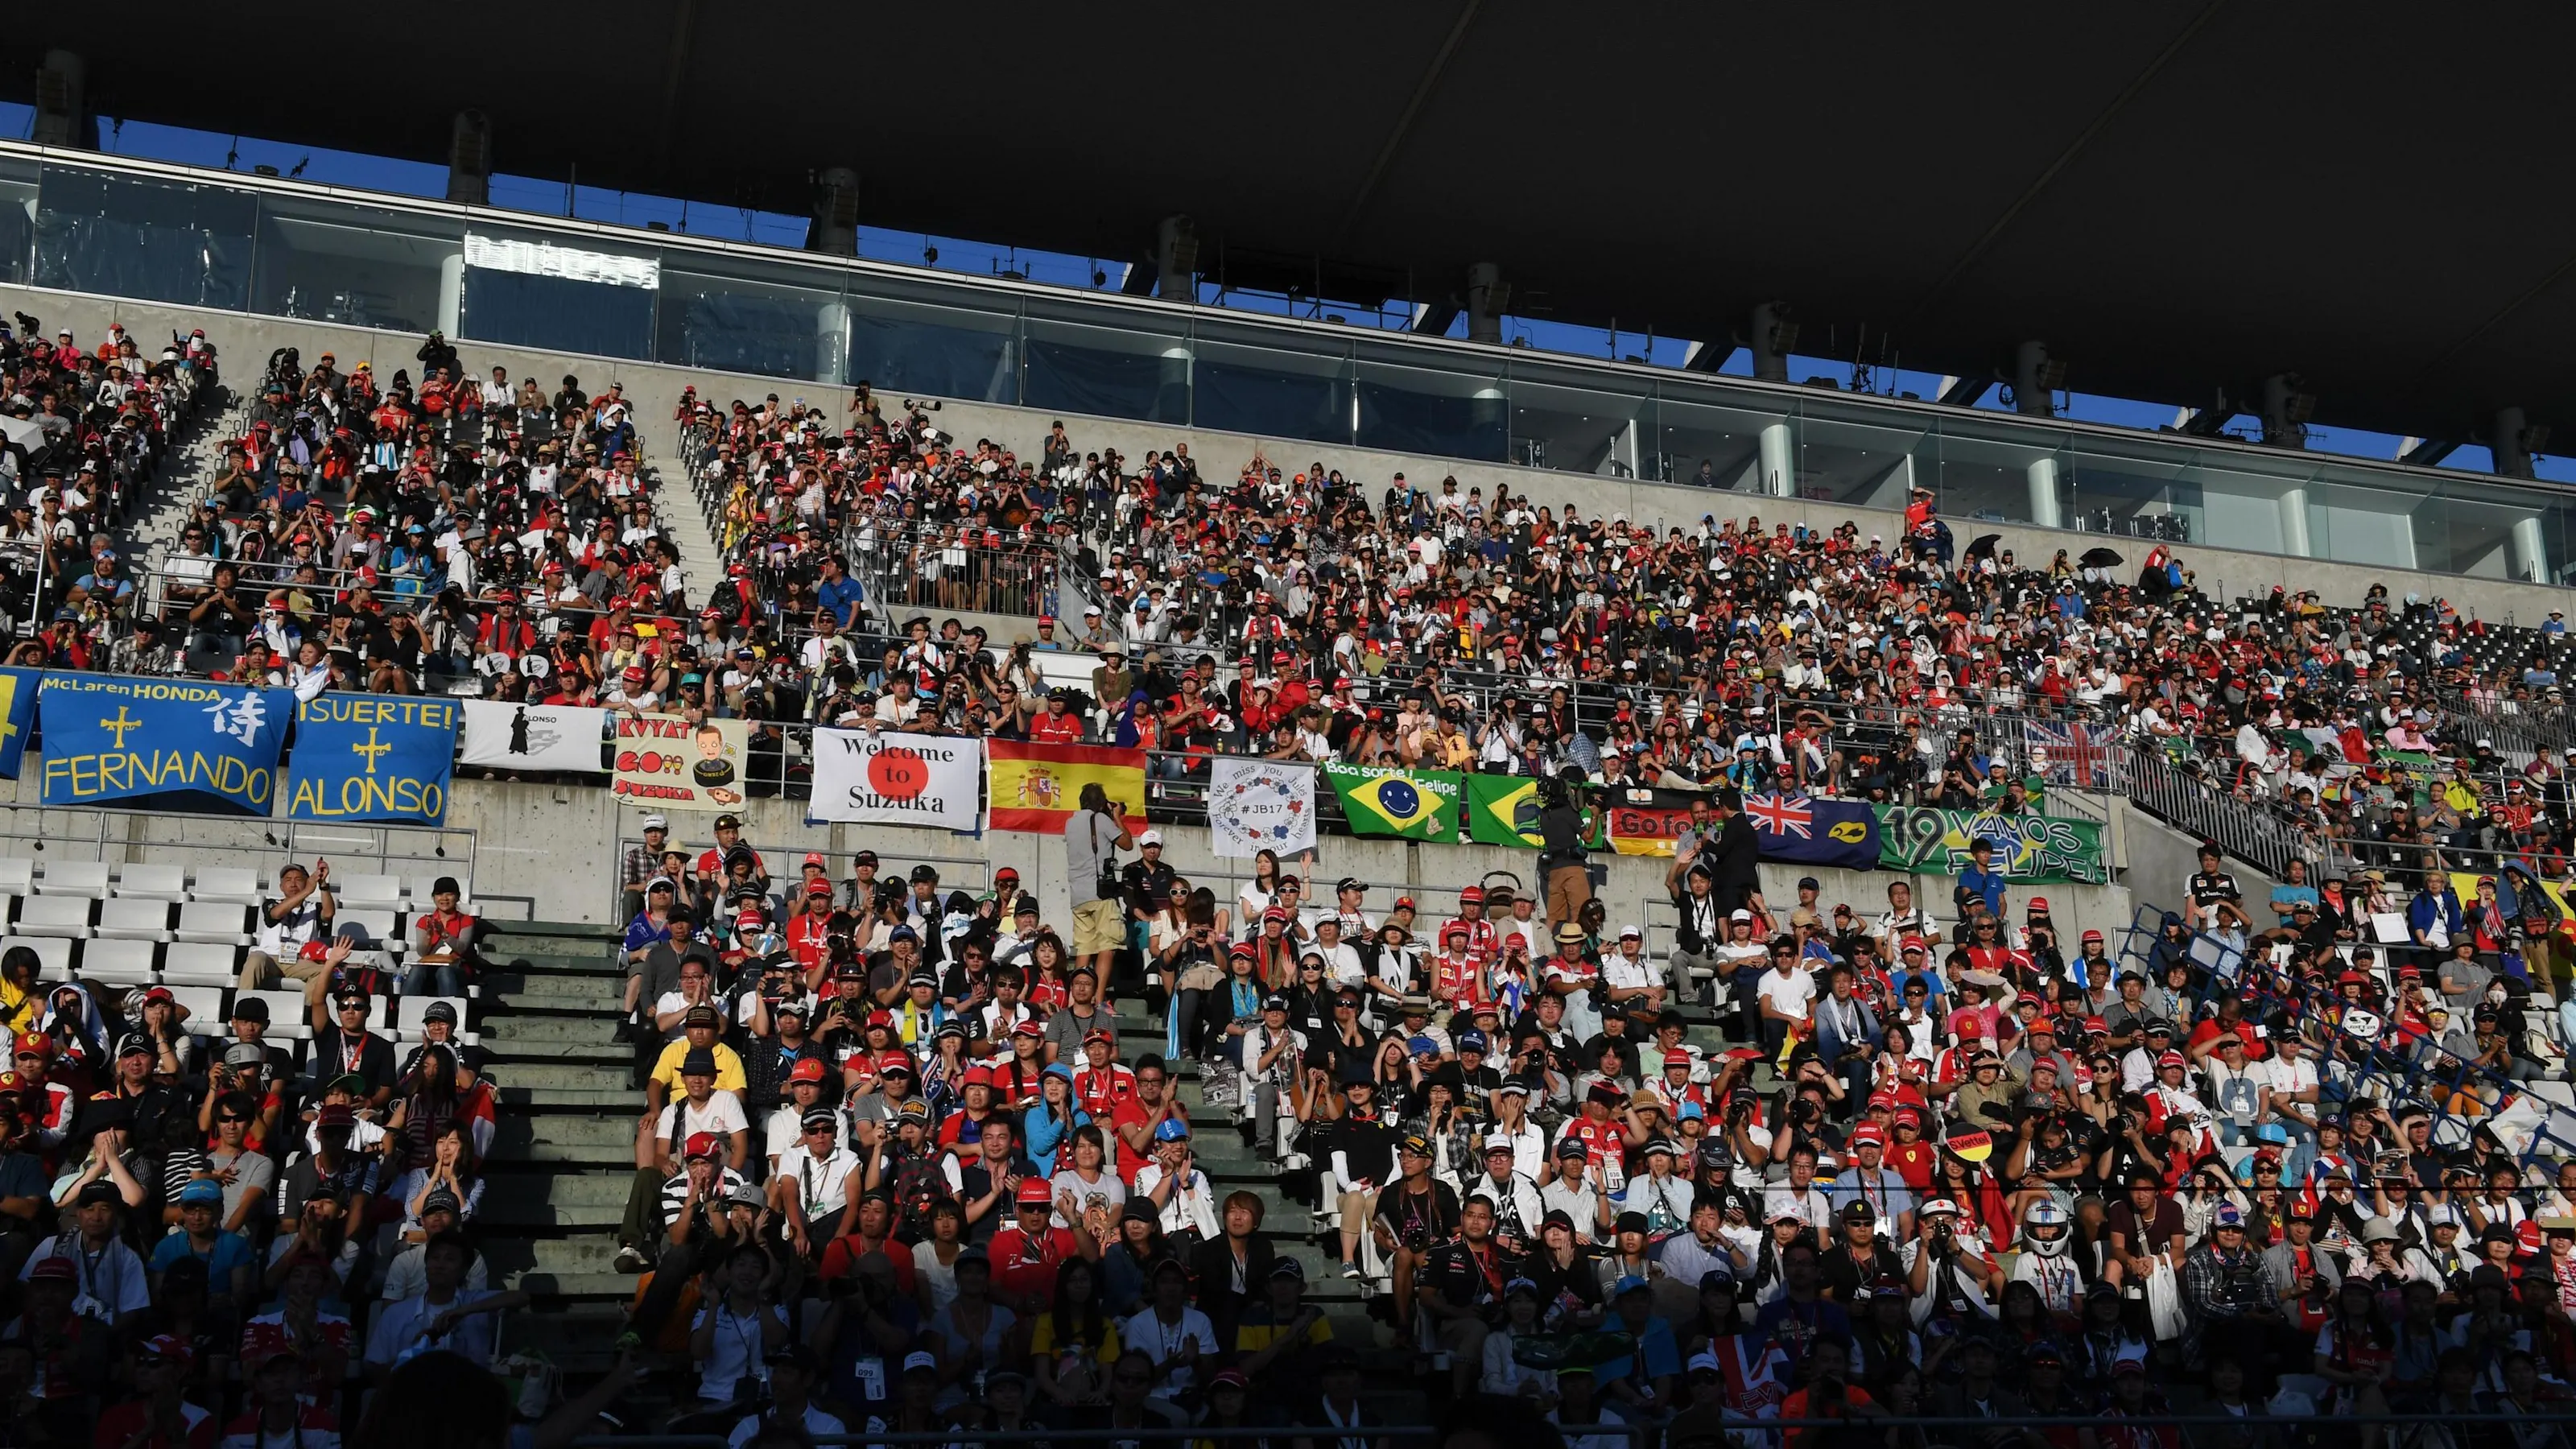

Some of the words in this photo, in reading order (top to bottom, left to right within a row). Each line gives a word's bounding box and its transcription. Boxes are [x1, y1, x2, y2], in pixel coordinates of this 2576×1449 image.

[43, 678, 130, 696] McLaren
[133, 684, 222, 702] HONDA
[202, 691, 266, 748] 侍
[618, 717, 691, 739] KVYAT
[841, 737, 954, 762] Welcome
[44, 749, 270, 804] FERNANDO
[884, 764, 910, 784] to
[1324, 762, 1359, 776] Boa
[613, 779, 695, 801] SUZUKA
[1213, 782, 1229, 798] We
[1232, 766, 1256, 780] miss
[1263, 766, 1283, 777] you
[1288, 777, 1307, 797] Jules
[1415, 778, 1457, 796] Felipe
[290, 776, 443, 818] ALONSO
[848, 786, 945, 814] Suzuka
[1241, 805, 1283, 814] #JB17
[1212, 813, 1245, 845] Forever
[1250, 844, 1261, 852] in
[1270, 842, 1288, 853] our
[1290, 807, 1313, 840] hearts
[1620, 811, 1658, 835] Go
[1662, 814, 1692, 836] fo
[1949, 811, 2083, 852] VAMOS
[1882, 806, 1948, 867] 19
[1950, 1135, 1989, 1151] S.Vettel
